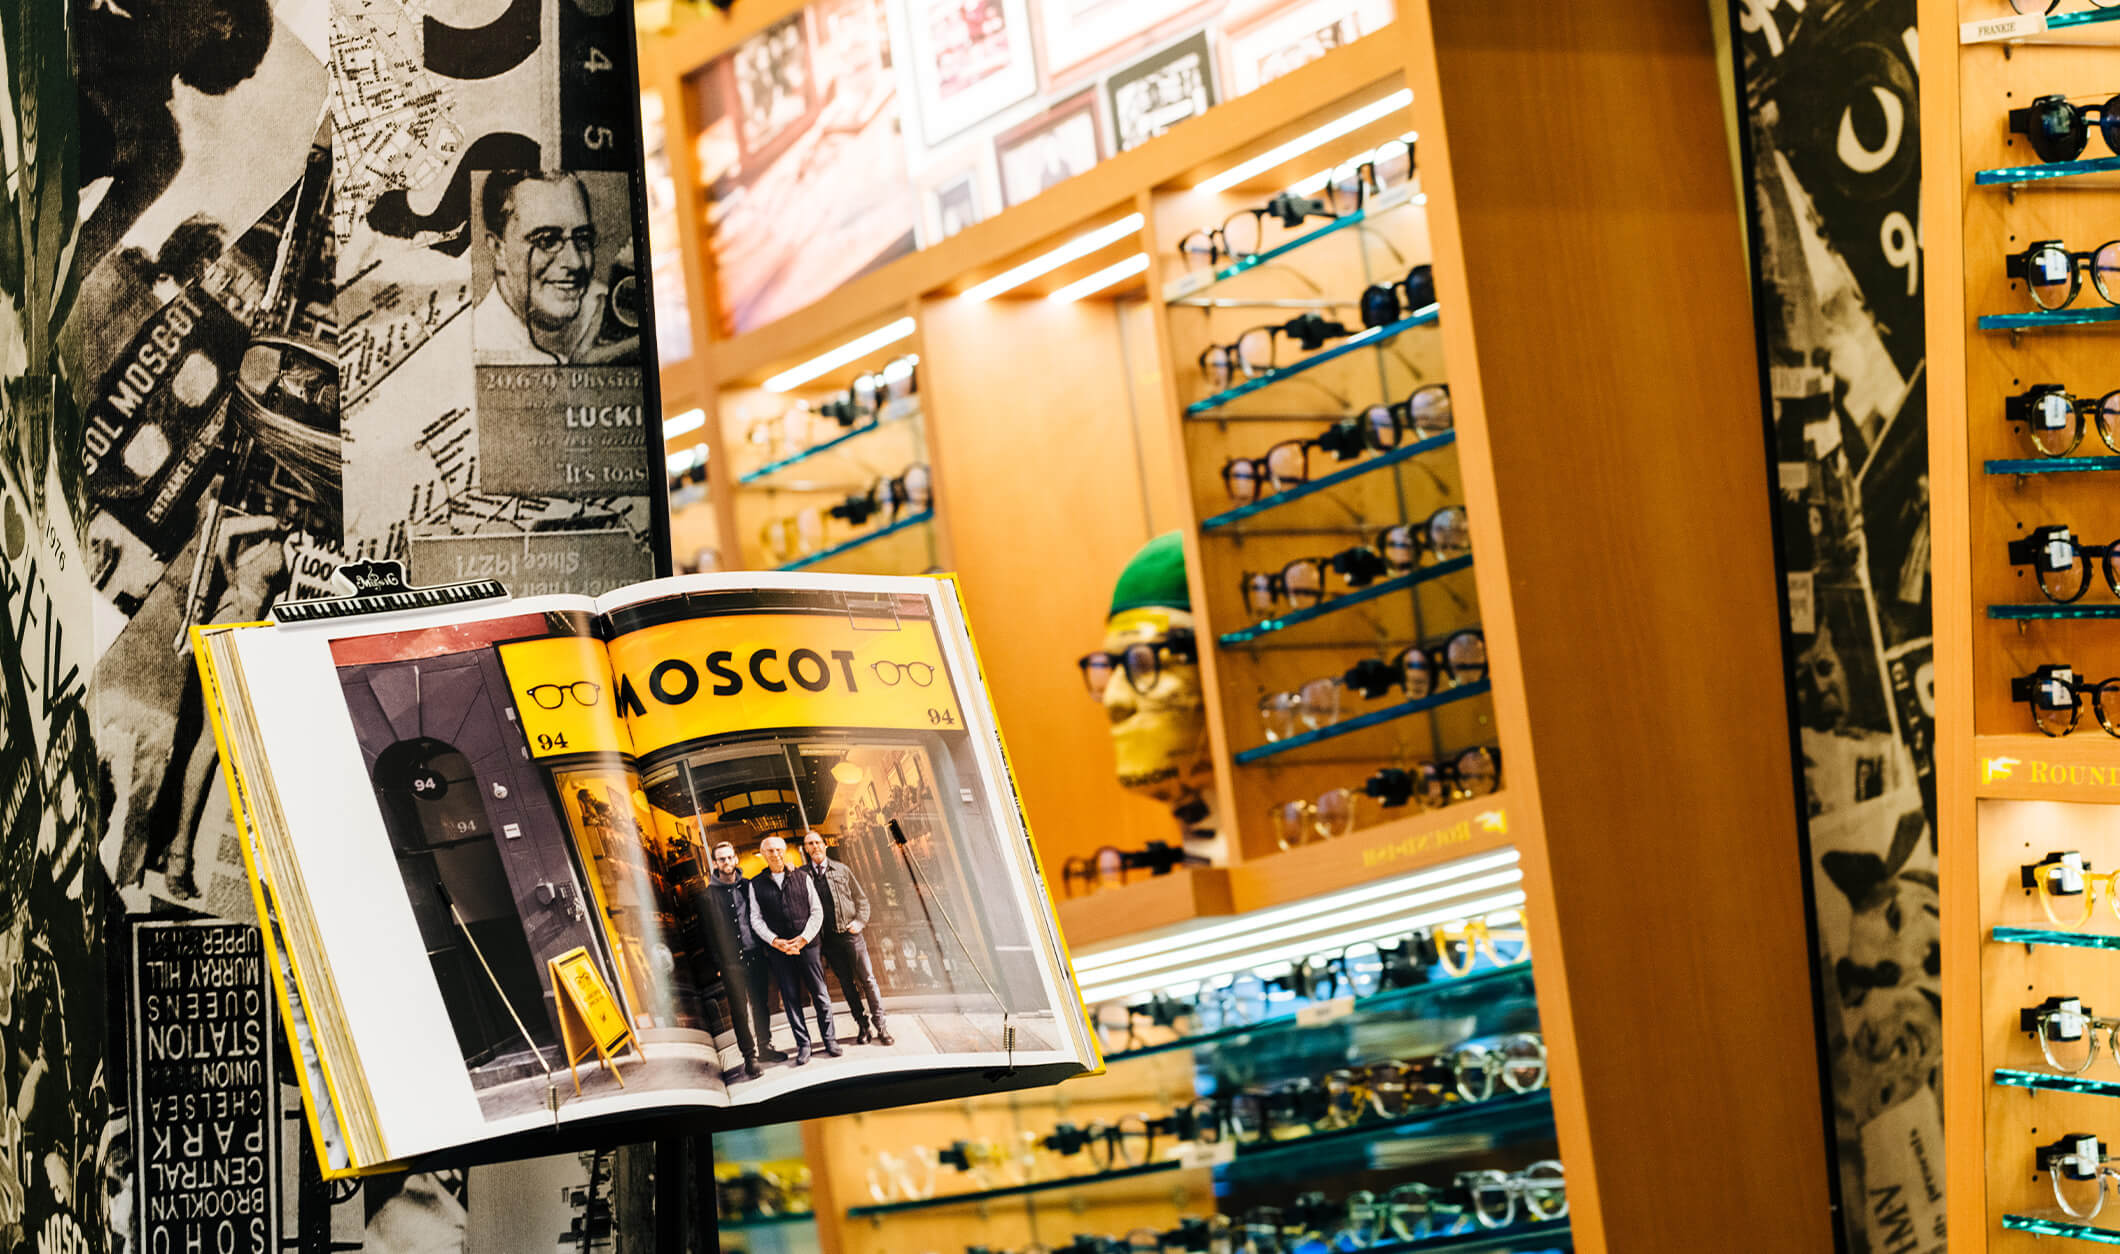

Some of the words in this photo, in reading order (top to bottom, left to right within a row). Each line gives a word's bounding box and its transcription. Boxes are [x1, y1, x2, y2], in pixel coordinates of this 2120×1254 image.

[1977, 22, 2017, 38] FRANKIE
[584, 46, 613, 73] 4
[584, 124, 614, 150] 5
[82, 416, 124, 476] SOL
[107, 298, 203, 418] MOSCOT
[566, 405, 643, 428] LUCKI
[46, 519, 66, 572] 1976
[302, 555, 338, 581] LOO
[524, 551, 579, 576] Since
[615, 648, 860, 720] MOSCOT
[927, 707, 956, 726] 94
[537, 731, 569, 751] 94
[414, 777, 437, 792] 94
[457, 819, 477, 833] 94
[202, 927, 258, 955] UPPER
[146, 960, 181, 990] HILL
[190, 956, 259, 989] MURRAY
[147, 989, 260, 1022] QUEENS
[148, 1019, 261, 1062] STATION
[202, 1059, 262, 1088] UNION
[150, 1089, 263, 1122] CHELSEA
[152, 1118, 264, 1161] PARK
[151, 1155, 264, 1191] CENTRAL
[152, 1187, 265, 1221] BROOKLYN
[152, 1217, 265, 1254] SOHO
